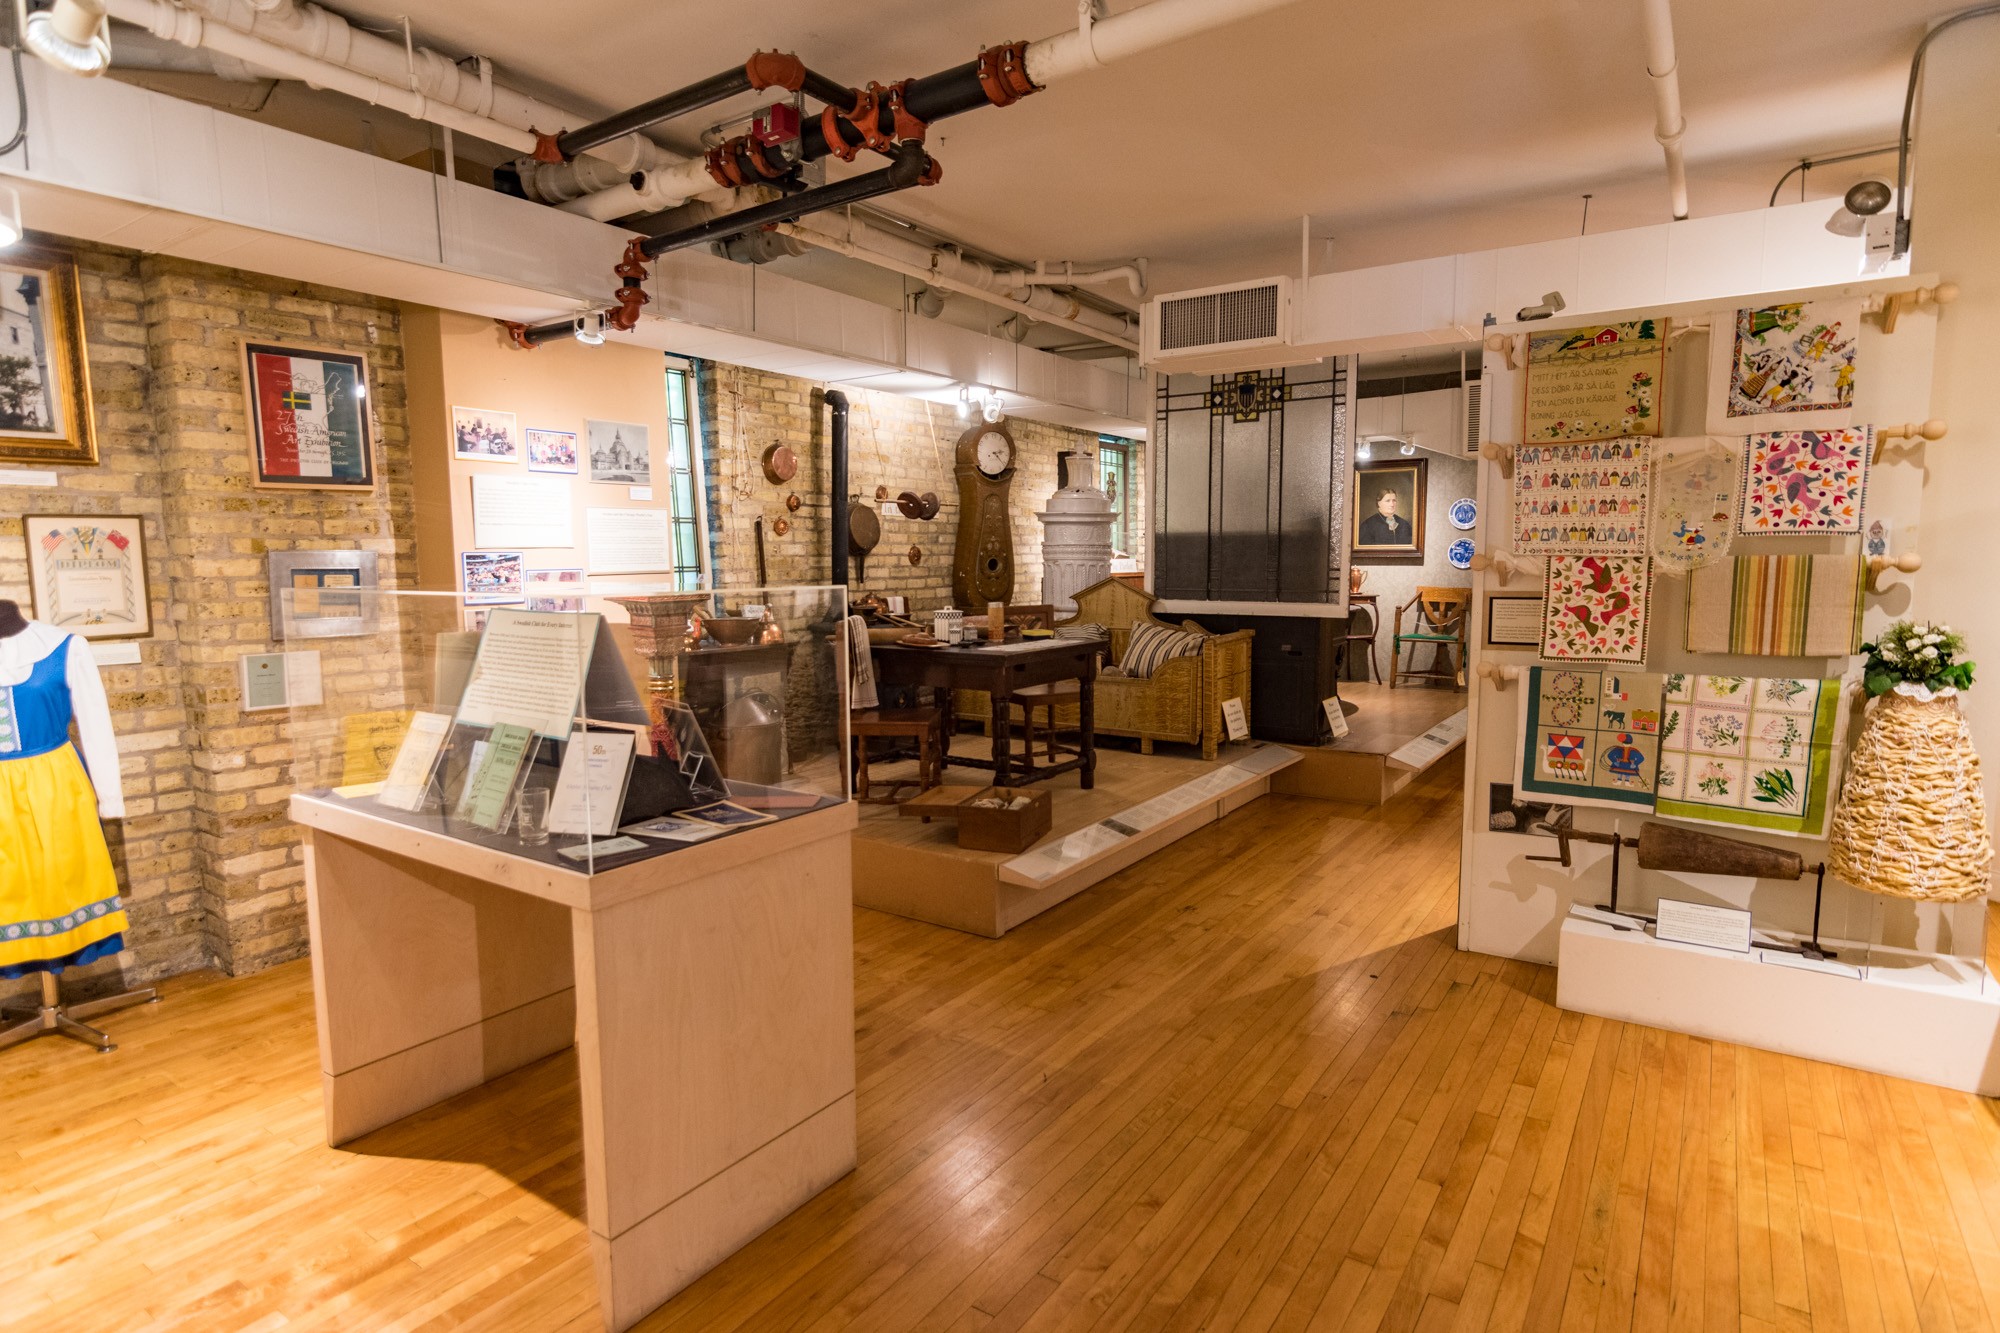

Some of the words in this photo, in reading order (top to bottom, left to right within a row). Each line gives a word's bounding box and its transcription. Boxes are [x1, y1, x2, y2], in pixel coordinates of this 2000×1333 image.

[1532, 373, 1551, 382] MITT
[1569, 369, 1580, 378] ÄR
[1595, 368, 1618, 377] RINGA
[1532, 385, 1551, 394] DESS
[1551, 384, 1570, 393] DÖRR
[1573, 382, 1585, 392] ÄR
[1531, 399, 1547, 408] MEN
[1548, 397, 1574, 406] ALDRIG
[1576, 396, 1585, 404] EN
[1586, 394, 1617, 403] KÄRARE
[276, 410, 304, 425] 27h
[1530, 411, 1555, 420] BONING
[1558, 410, 1573, 419] JAG
[282, 434, 301, 445] Art
